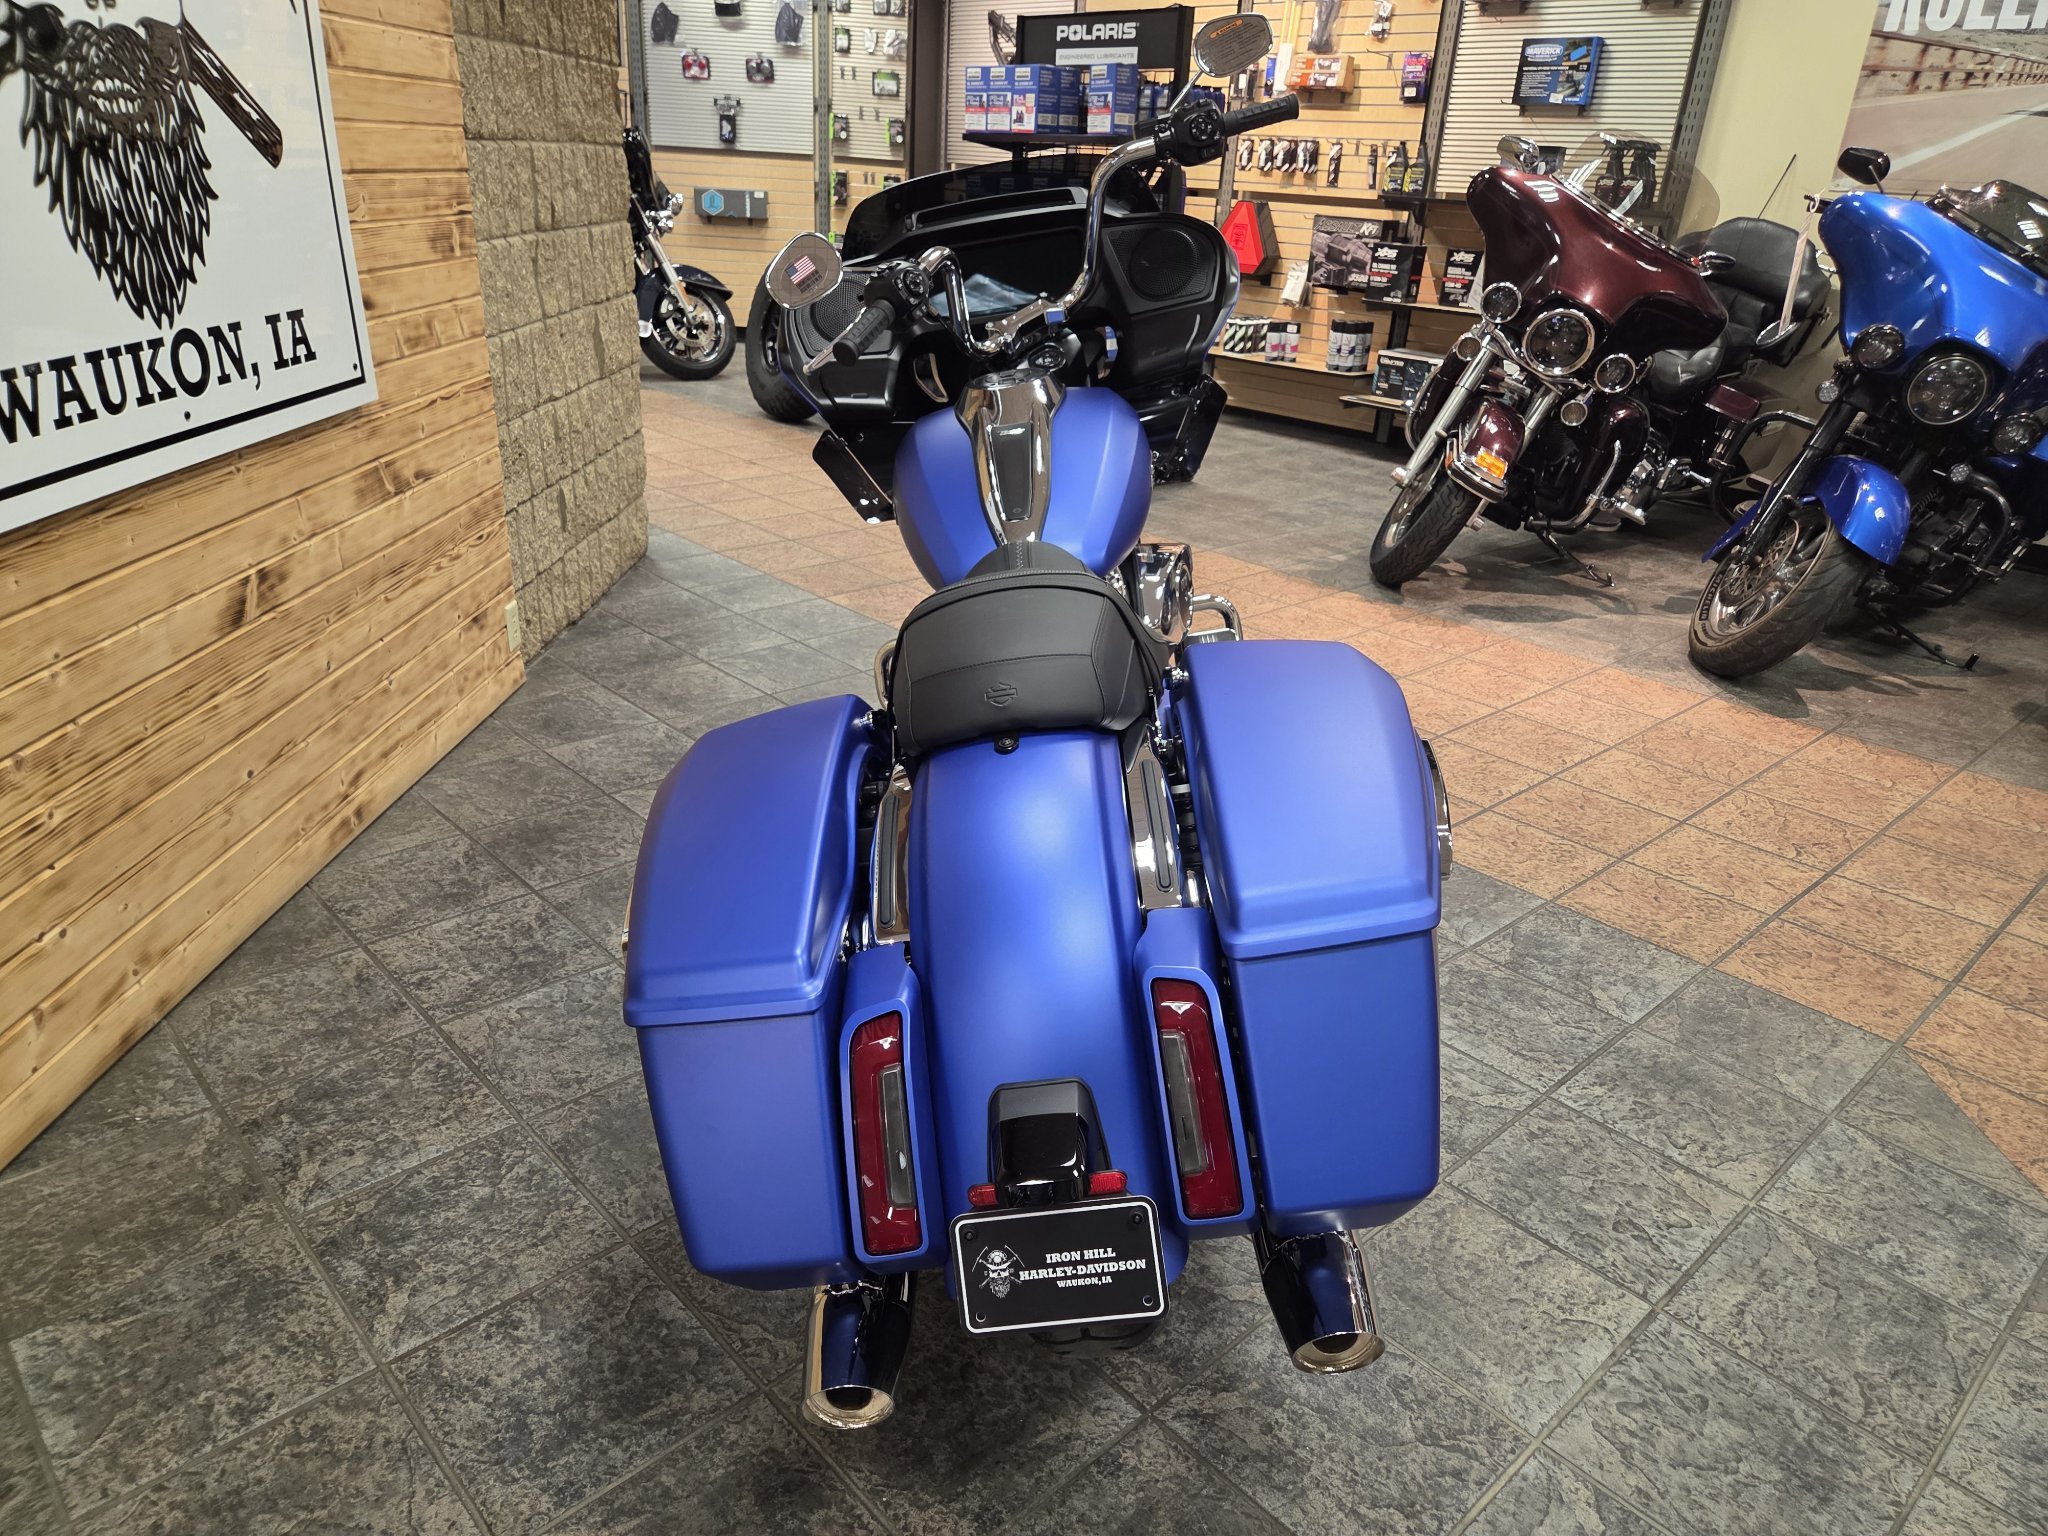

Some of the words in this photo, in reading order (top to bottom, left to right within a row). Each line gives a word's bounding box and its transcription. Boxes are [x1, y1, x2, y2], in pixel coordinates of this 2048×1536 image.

[1056, 22, 1137, 42] POLARIS
[1526, 47, 1561, 56] MAVERICK
[1375, 247, 1398, 258] XPS
[1450, 251, 1476, 263] XPS
[264, 308, 318, 372] IA
[1700, 574, 1723, 620] MICHELIN
[1045, 1251, 1081, 1264] IRON
[1083, 1247, 1116, 1259] HILL
[1018, 1258, 1147, 1281] HARLEY-DAVIDSON
